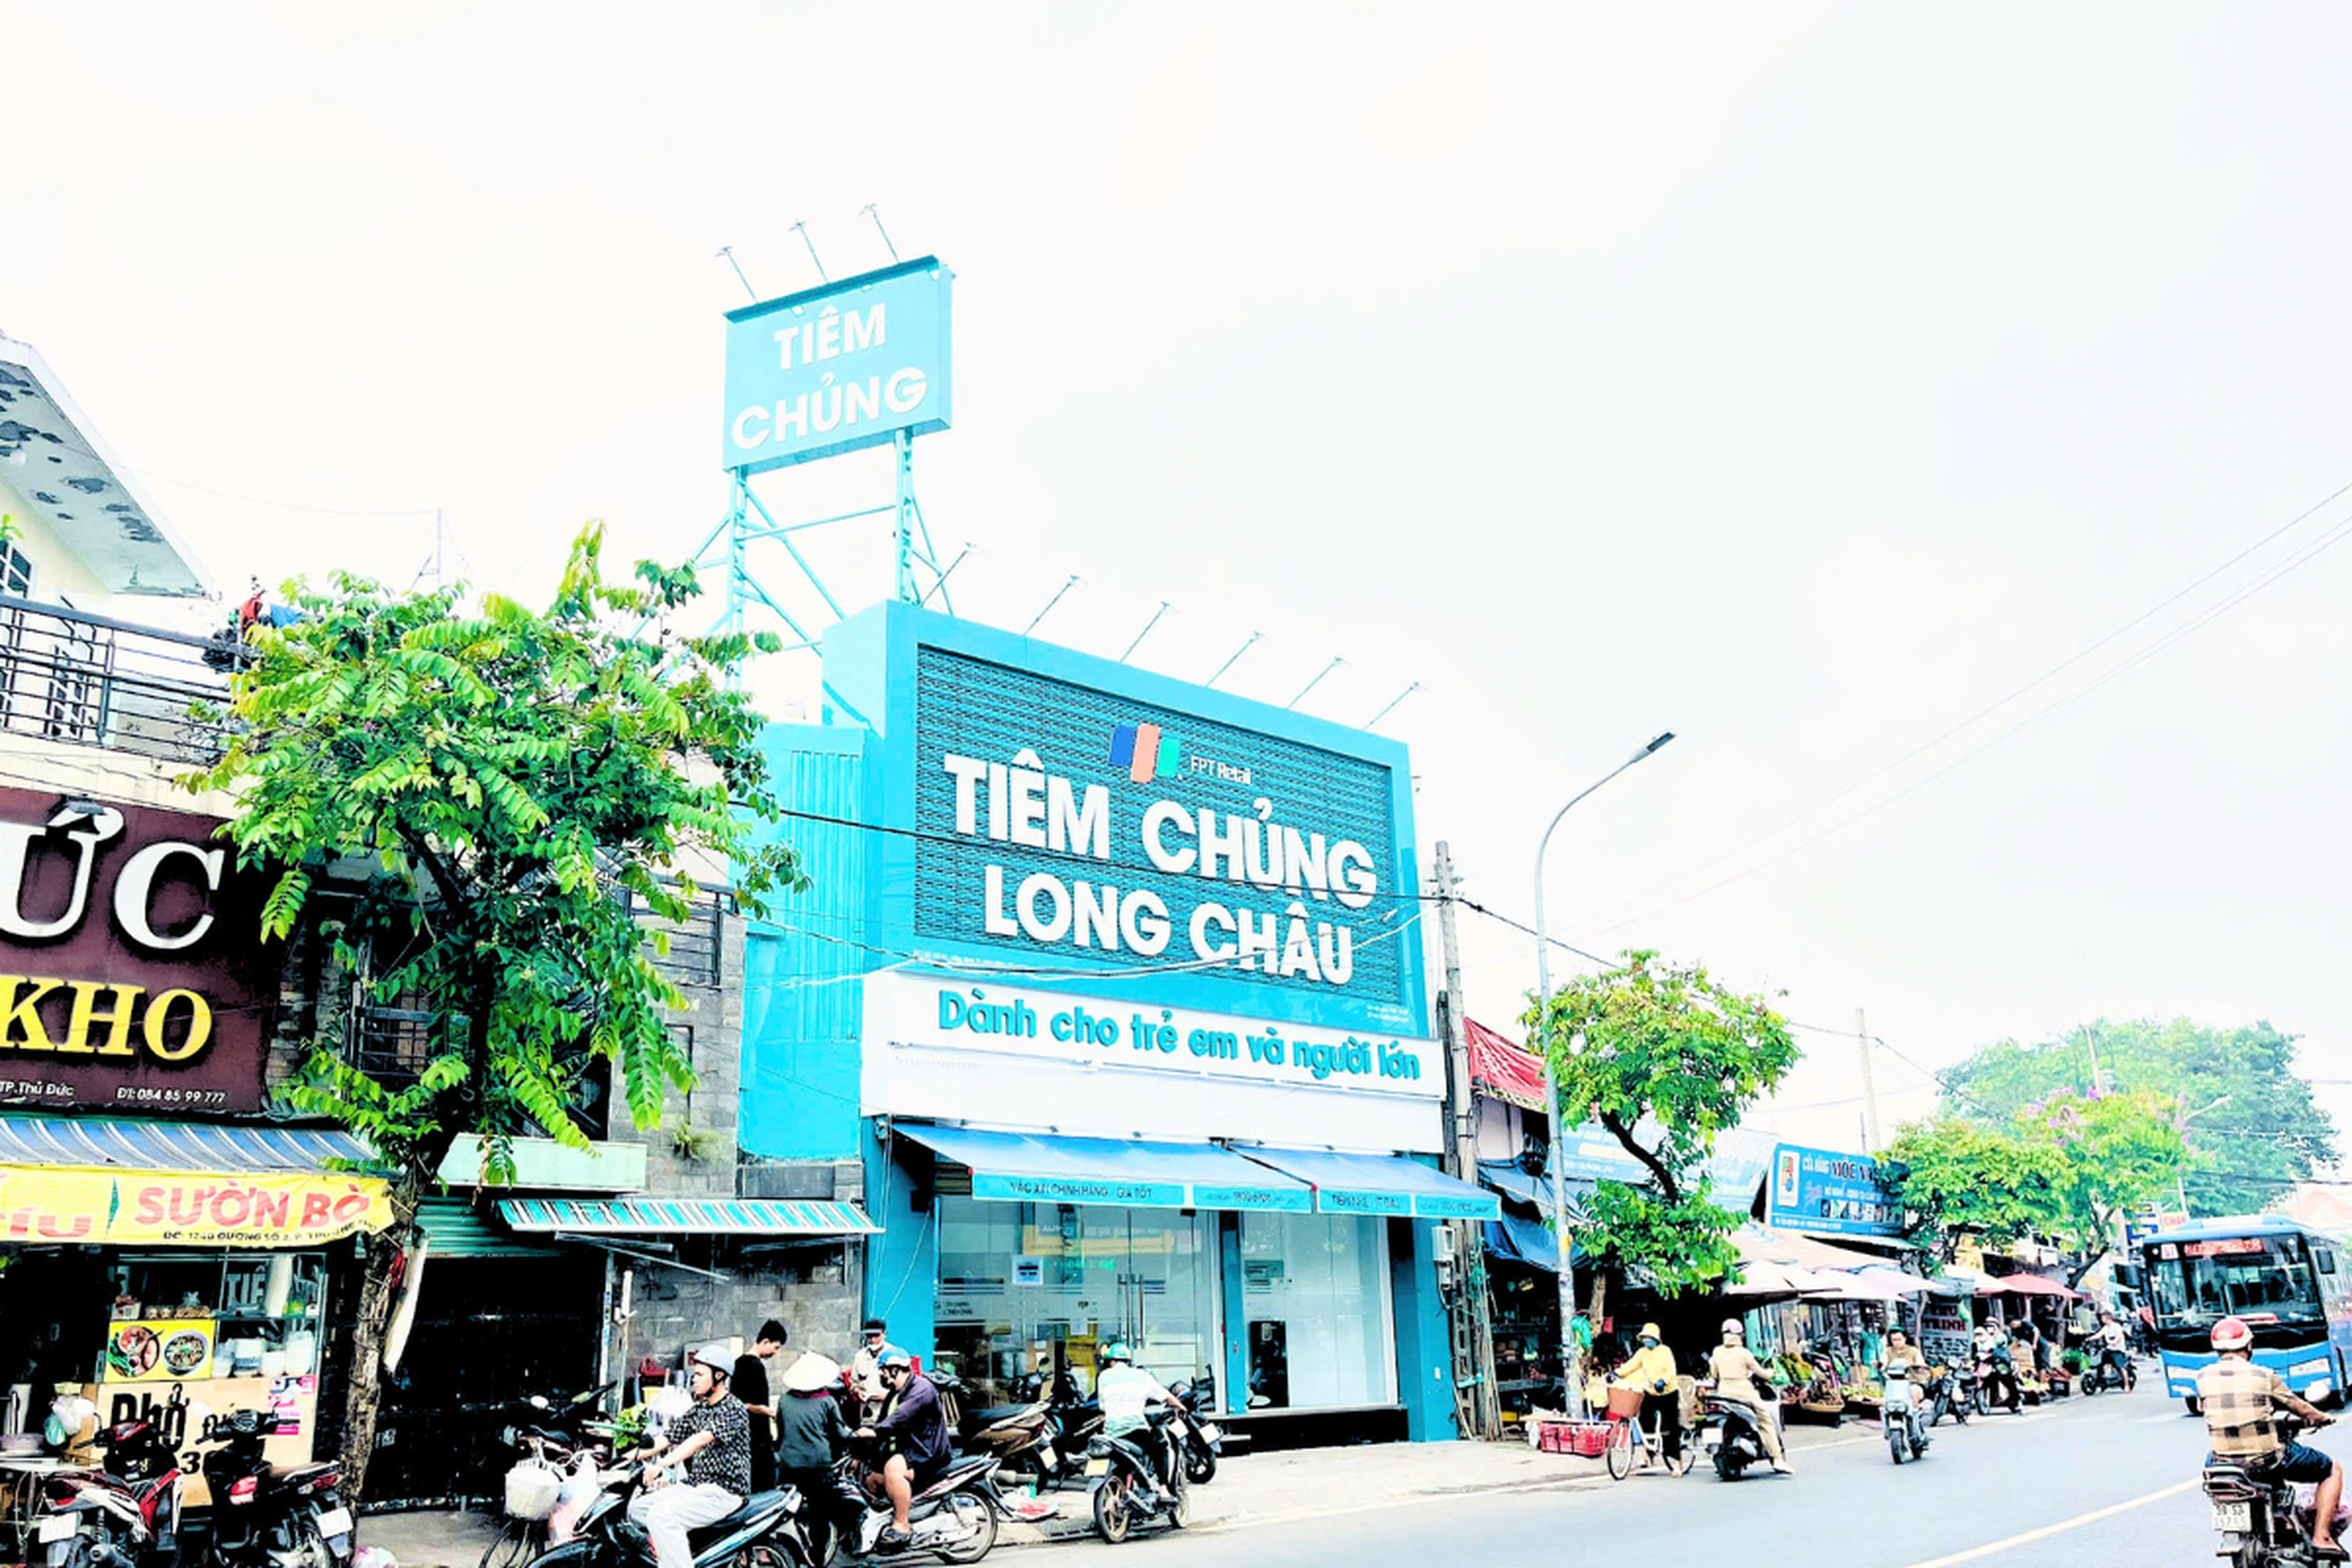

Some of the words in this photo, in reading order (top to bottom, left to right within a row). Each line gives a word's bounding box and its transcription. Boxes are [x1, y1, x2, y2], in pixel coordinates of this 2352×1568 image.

[775, 302, 886, 370] TIÊM
[732, 367, 927, 449] CHỦNG
[1191, 755, 1216, 776] FPT
[944, 749, 1110, 860] TIÊM
[1142, 797, 1377, 908] CHỦNG
[985, 865, 1171, 956] LONG
[1189, 902, 1353, 985] CHÂU
[0, 974, 212, 1061] KHO
[939, 988, 1037, 1038] Dành
[1050, 1007, 1120, 1046] cho
[1130, 1010, 1179, 1054] trẻ
[1188, 1029, 1238, 1059] em
[1247, 1027, 1285, 1065] và
[1293, 1036, 1373, 1079] người
[1378, 1040, 1420, 1079] lớn
[46, 1082, 75, 1097] Đức
[134, 1179, 290, 1228] SƯỜN
[300, 1183, 371, 1228] BÒ
